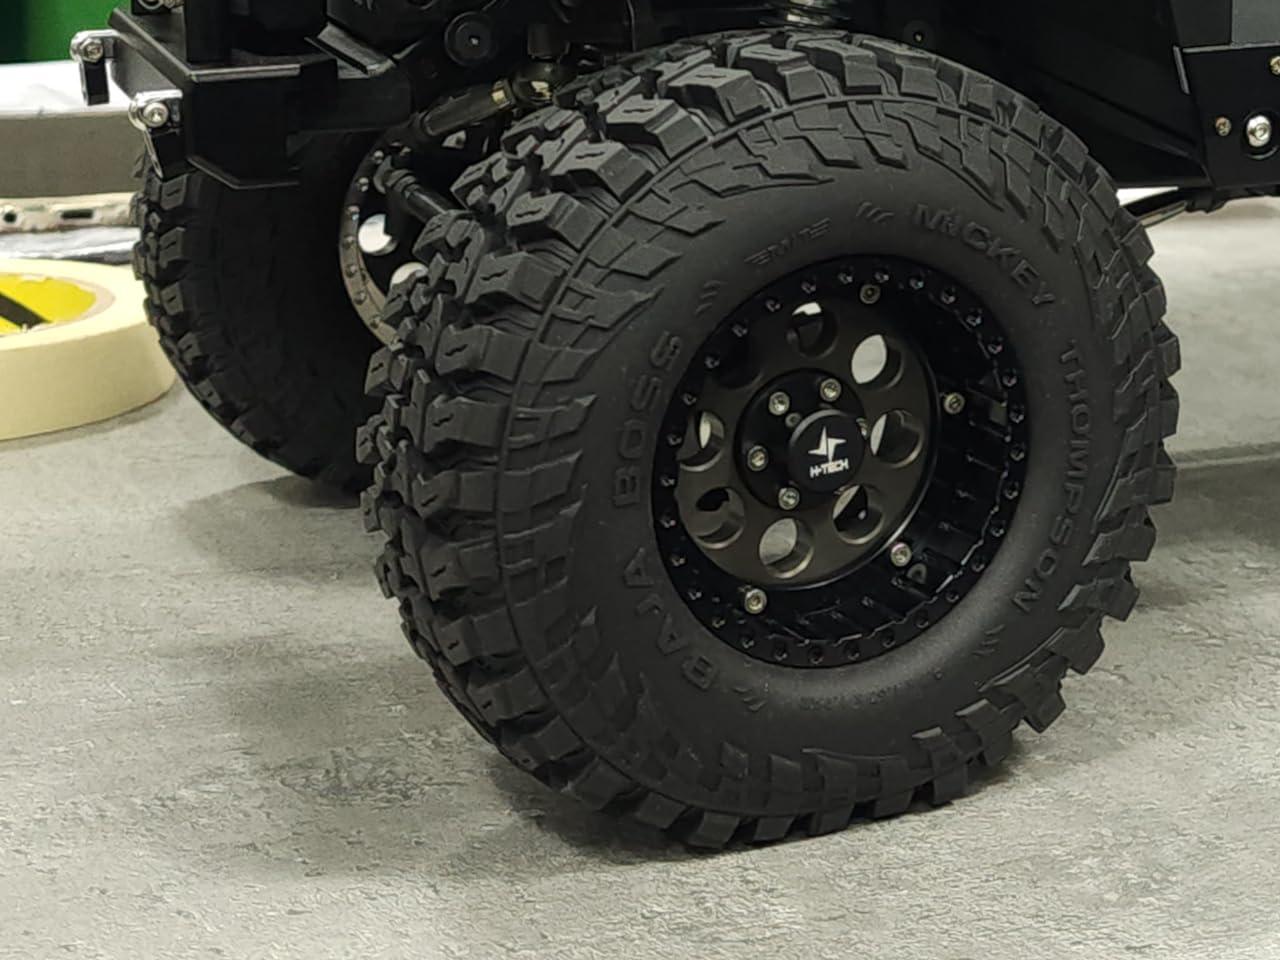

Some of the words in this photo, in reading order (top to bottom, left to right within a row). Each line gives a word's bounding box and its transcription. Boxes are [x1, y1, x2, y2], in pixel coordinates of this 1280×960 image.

[613, 330, 686, 508] BOSS
[809, 457, 849, 480] H-TECH
[1011, 339, 1102, 613] THOMPSON
[622, 546, 717, 688] BAJA
